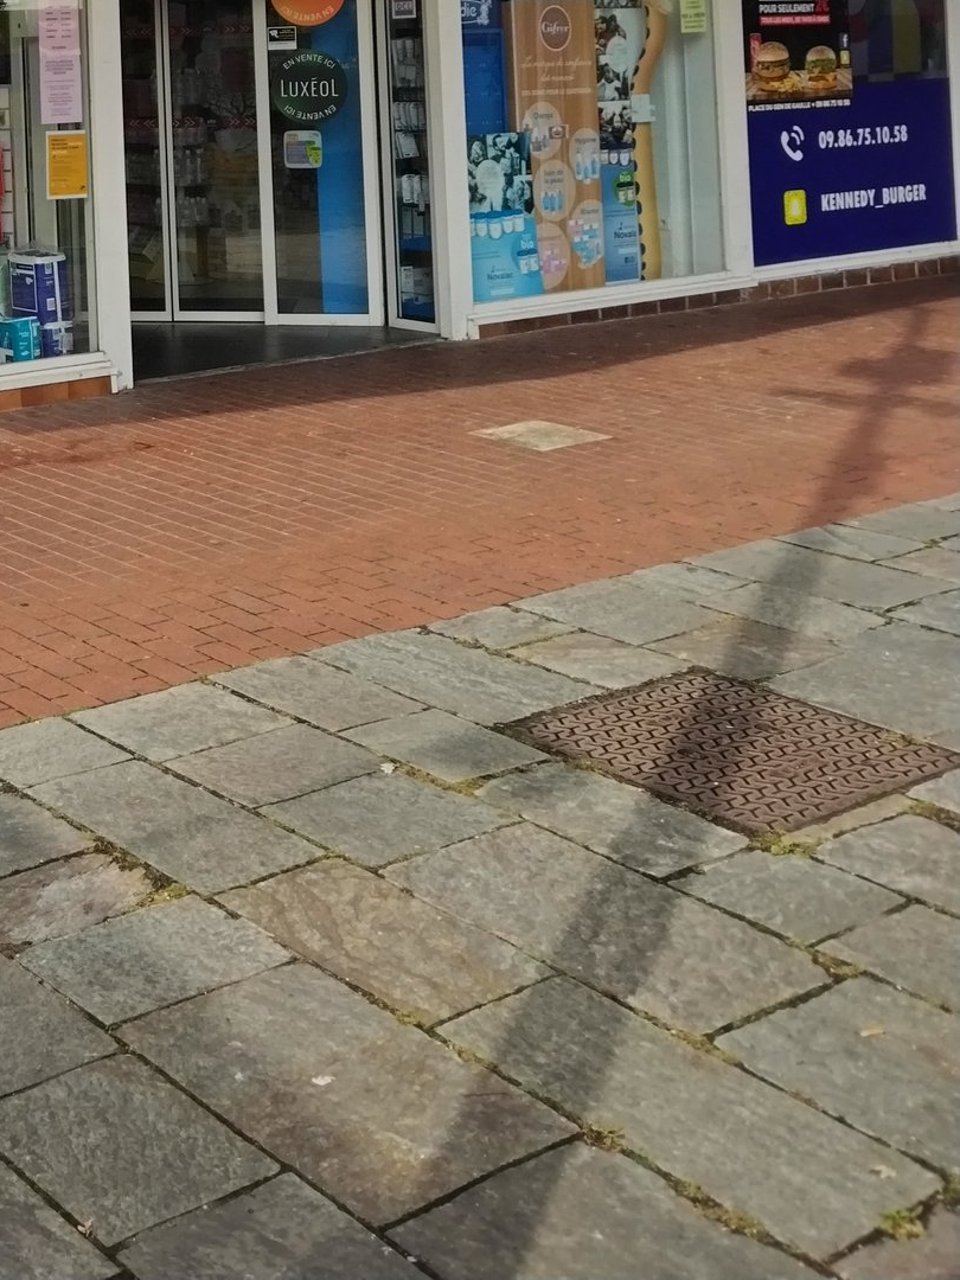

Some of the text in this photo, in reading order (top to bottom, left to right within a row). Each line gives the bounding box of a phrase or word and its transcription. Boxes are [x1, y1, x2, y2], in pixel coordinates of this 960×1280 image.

[542, 20, 569, 34] Gifrer
[282, 53, 337, 70] EN VENTE ICI
[280, 76, 339, 98] LUXÉOL
[283, 104, 337, 120] EN VENTE ICI
[818, 124, 908, 149] 09.86.75.10.58
[821, 184, 927, 212] KENNEDY_BURGER
